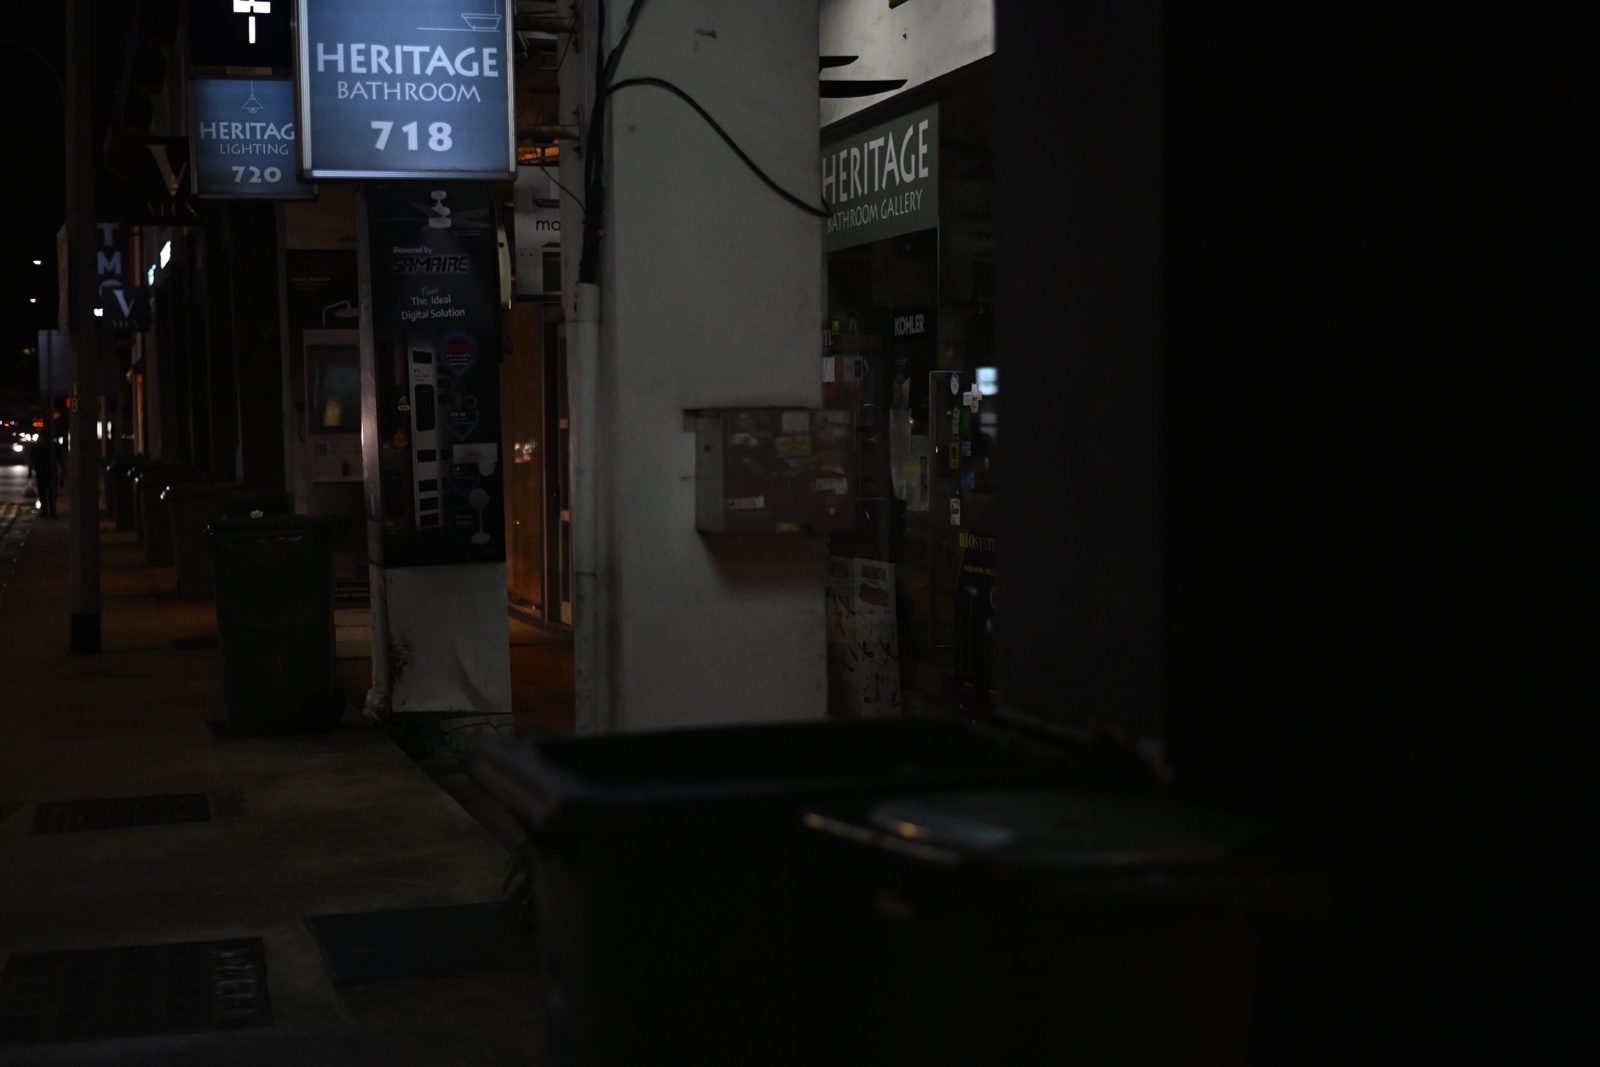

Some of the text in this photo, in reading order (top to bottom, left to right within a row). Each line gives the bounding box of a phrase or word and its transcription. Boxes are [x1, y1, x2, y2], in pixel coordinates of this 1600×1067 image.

[316, 42, 499, 78] HERITAGE
[337, 81, 481, 103] BATHROOM
[370, 120, 453, 151] 718
[219, 143, 289, 156] LIGHTING
[822, 119, 929, 204] HERITAGE
[231, 166, 282, 184] 720
[880, 188, 923, 219] GALLERY
[392, 246, 433, 256] Powered by
[393, 255, 471, 273] SAMAIRE
[410, 294, 452, 306] The Ideal
[401, 308, 466, 322] Digital Solution
[894, 313, 926, 337] KOHLER
